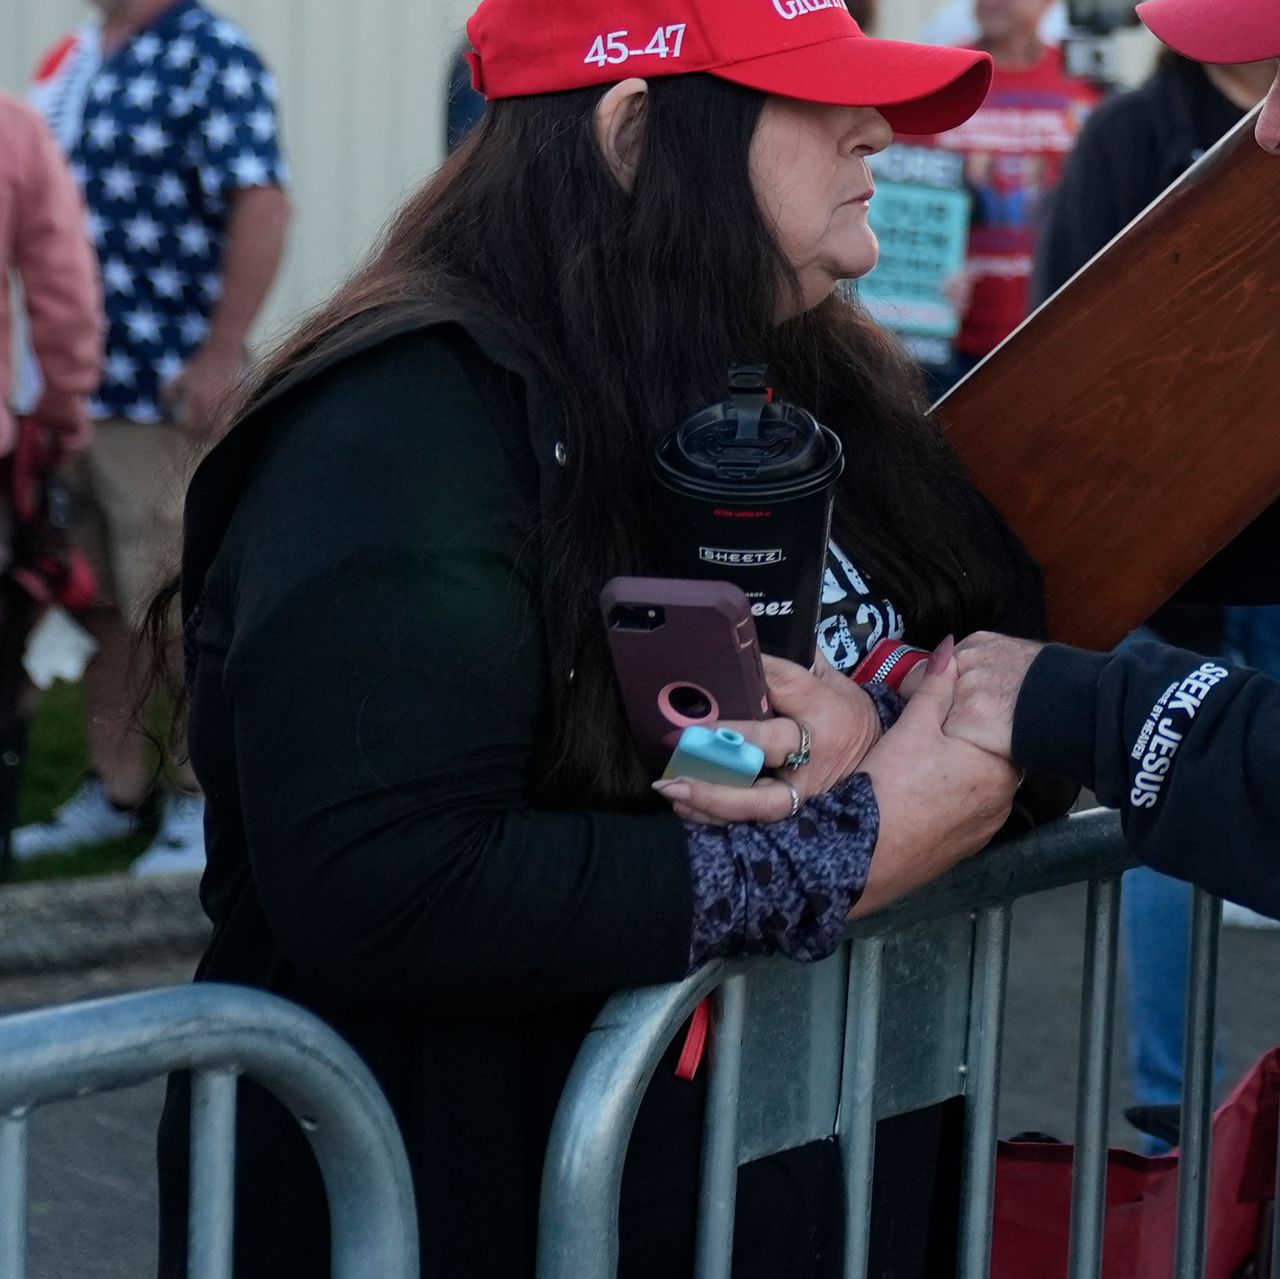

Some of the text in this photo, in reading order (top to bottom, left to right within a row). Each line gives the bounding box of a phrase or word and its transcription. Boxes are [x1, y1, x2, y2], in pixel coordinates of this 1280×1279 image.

[583, 23, 687, 67] 45-47
[703, 549, 777, 563] SHEETZ
[1130, 662, 1229, 809] SEEK JESUS
[1131, 681, 1181, 761] MADE BY HEAVEN
